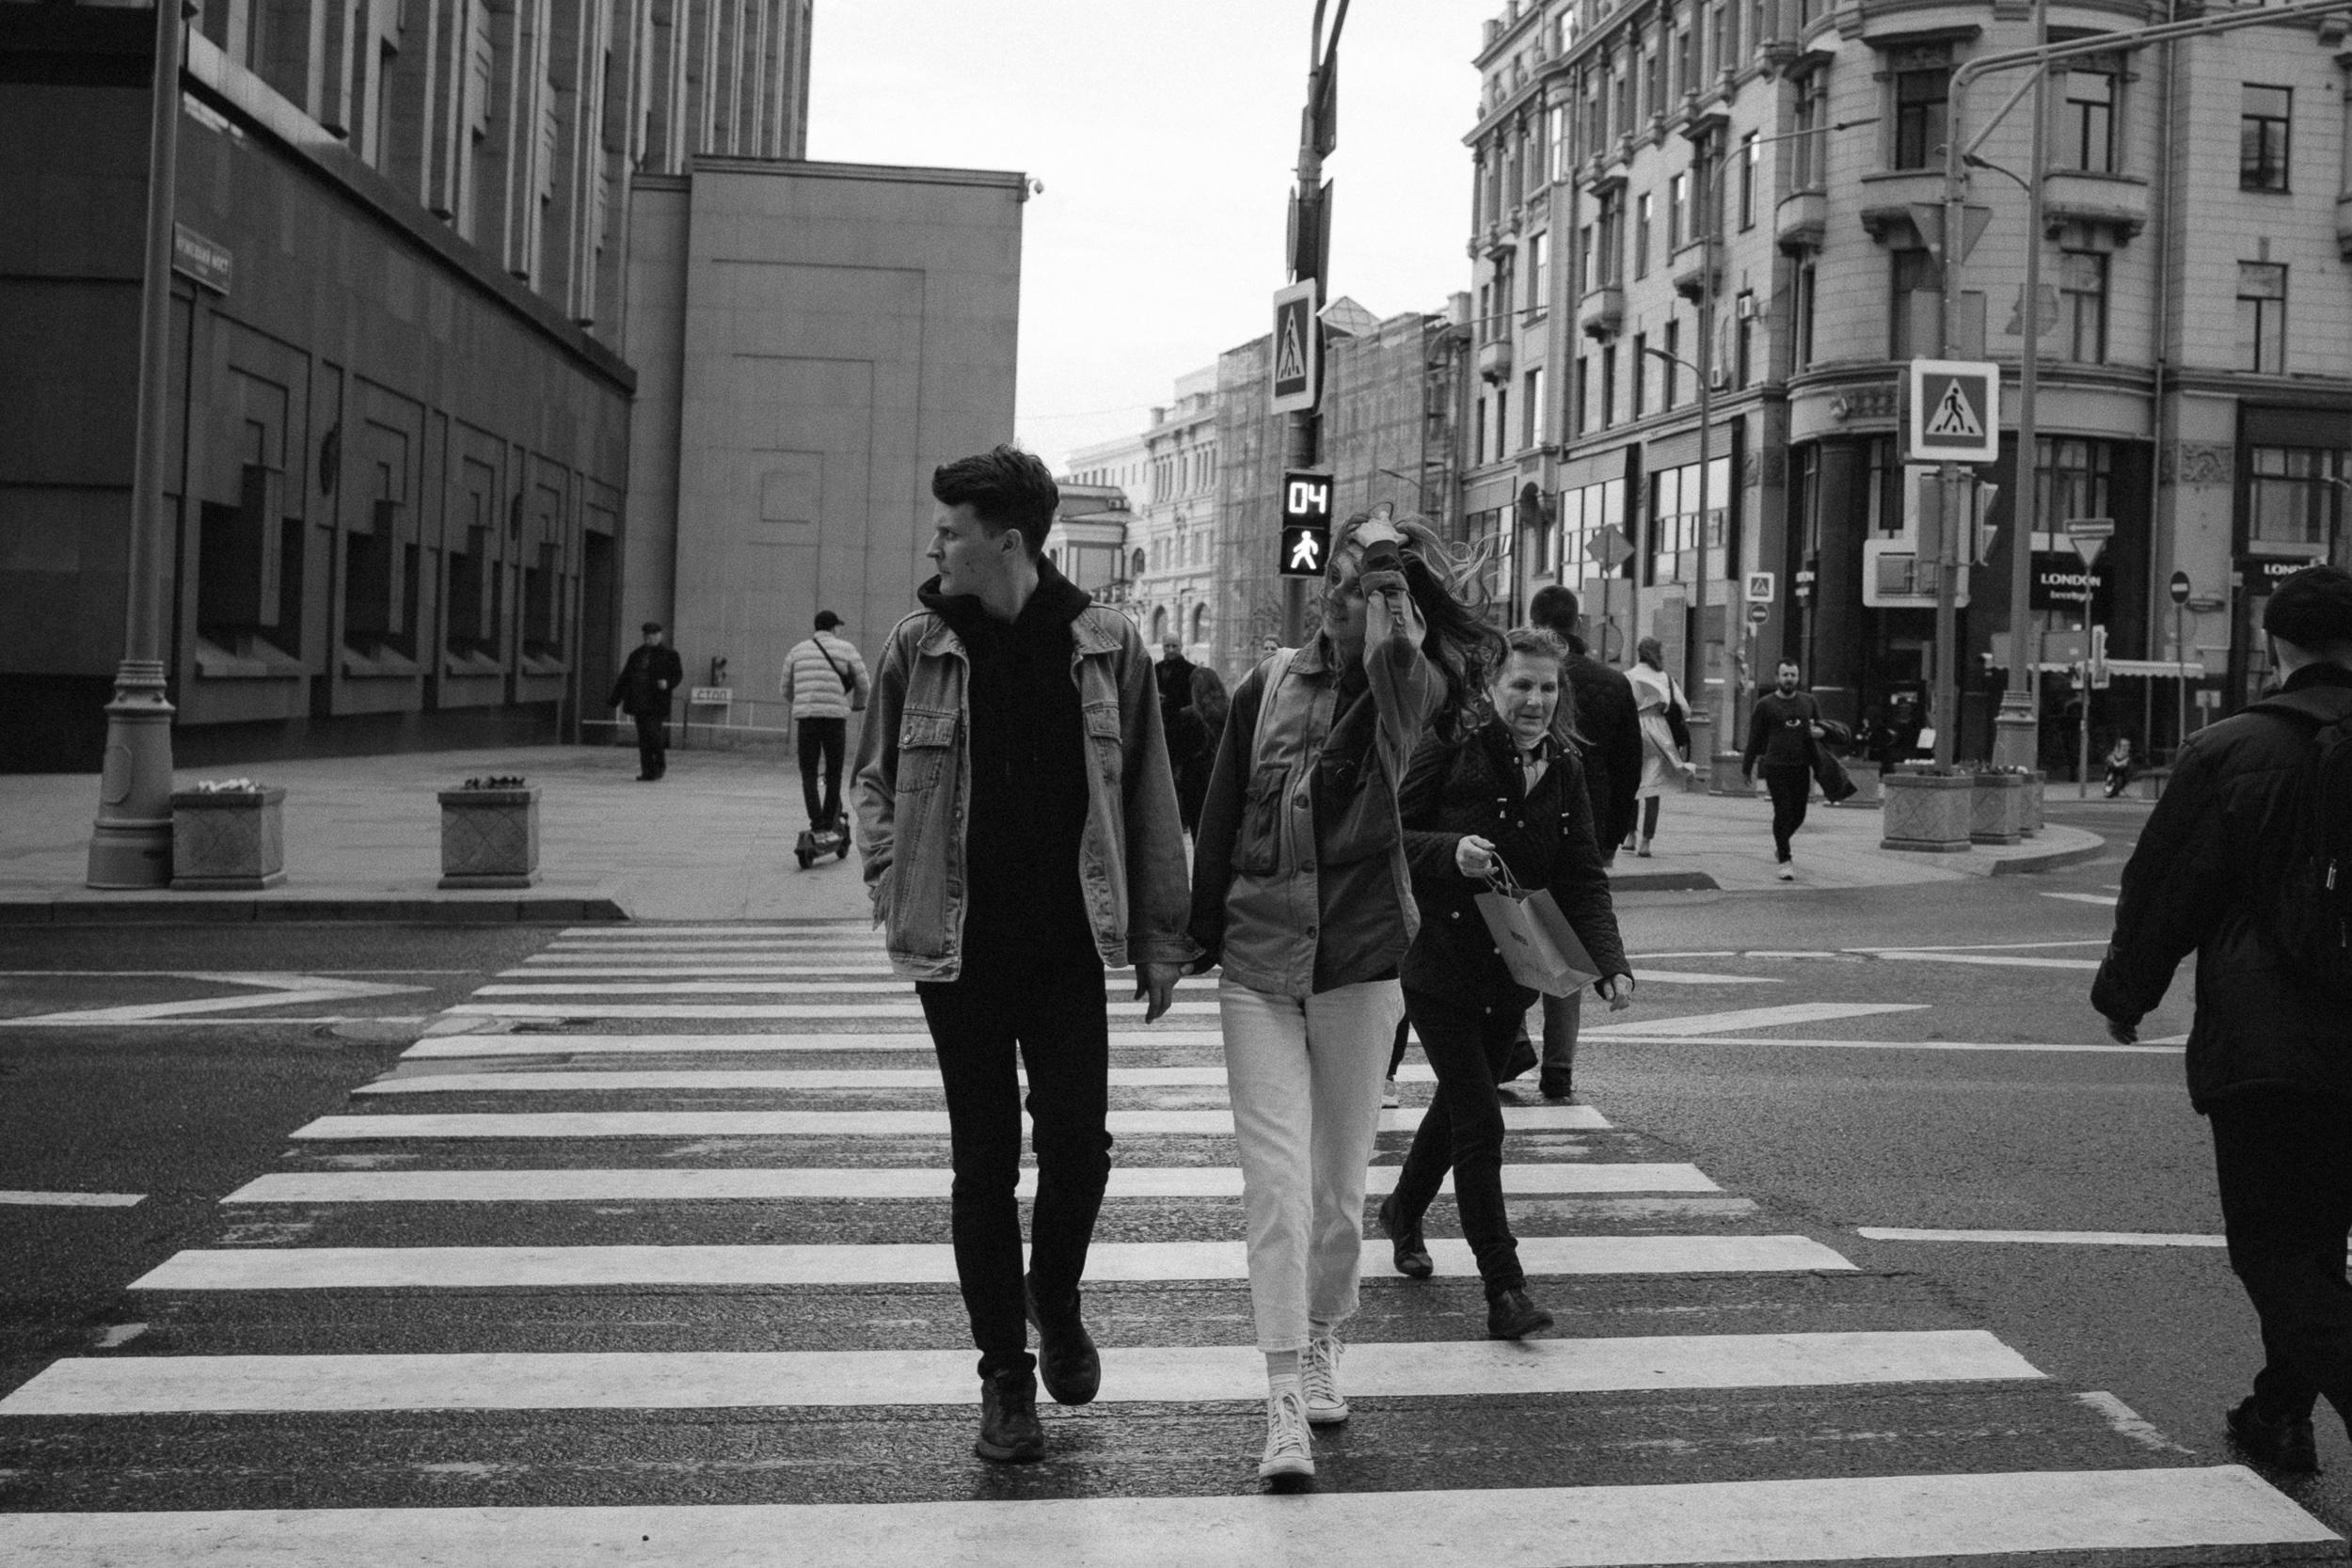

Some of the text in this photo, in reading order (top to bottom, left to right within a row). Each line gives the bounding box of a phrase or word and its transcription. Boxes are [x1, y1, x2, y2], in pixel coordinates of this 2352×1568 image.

[1288, 482, 1327, 514] 04
[2040, 572, 2102, 588] LONDON
[697, 689, 727, 701] СТОП
